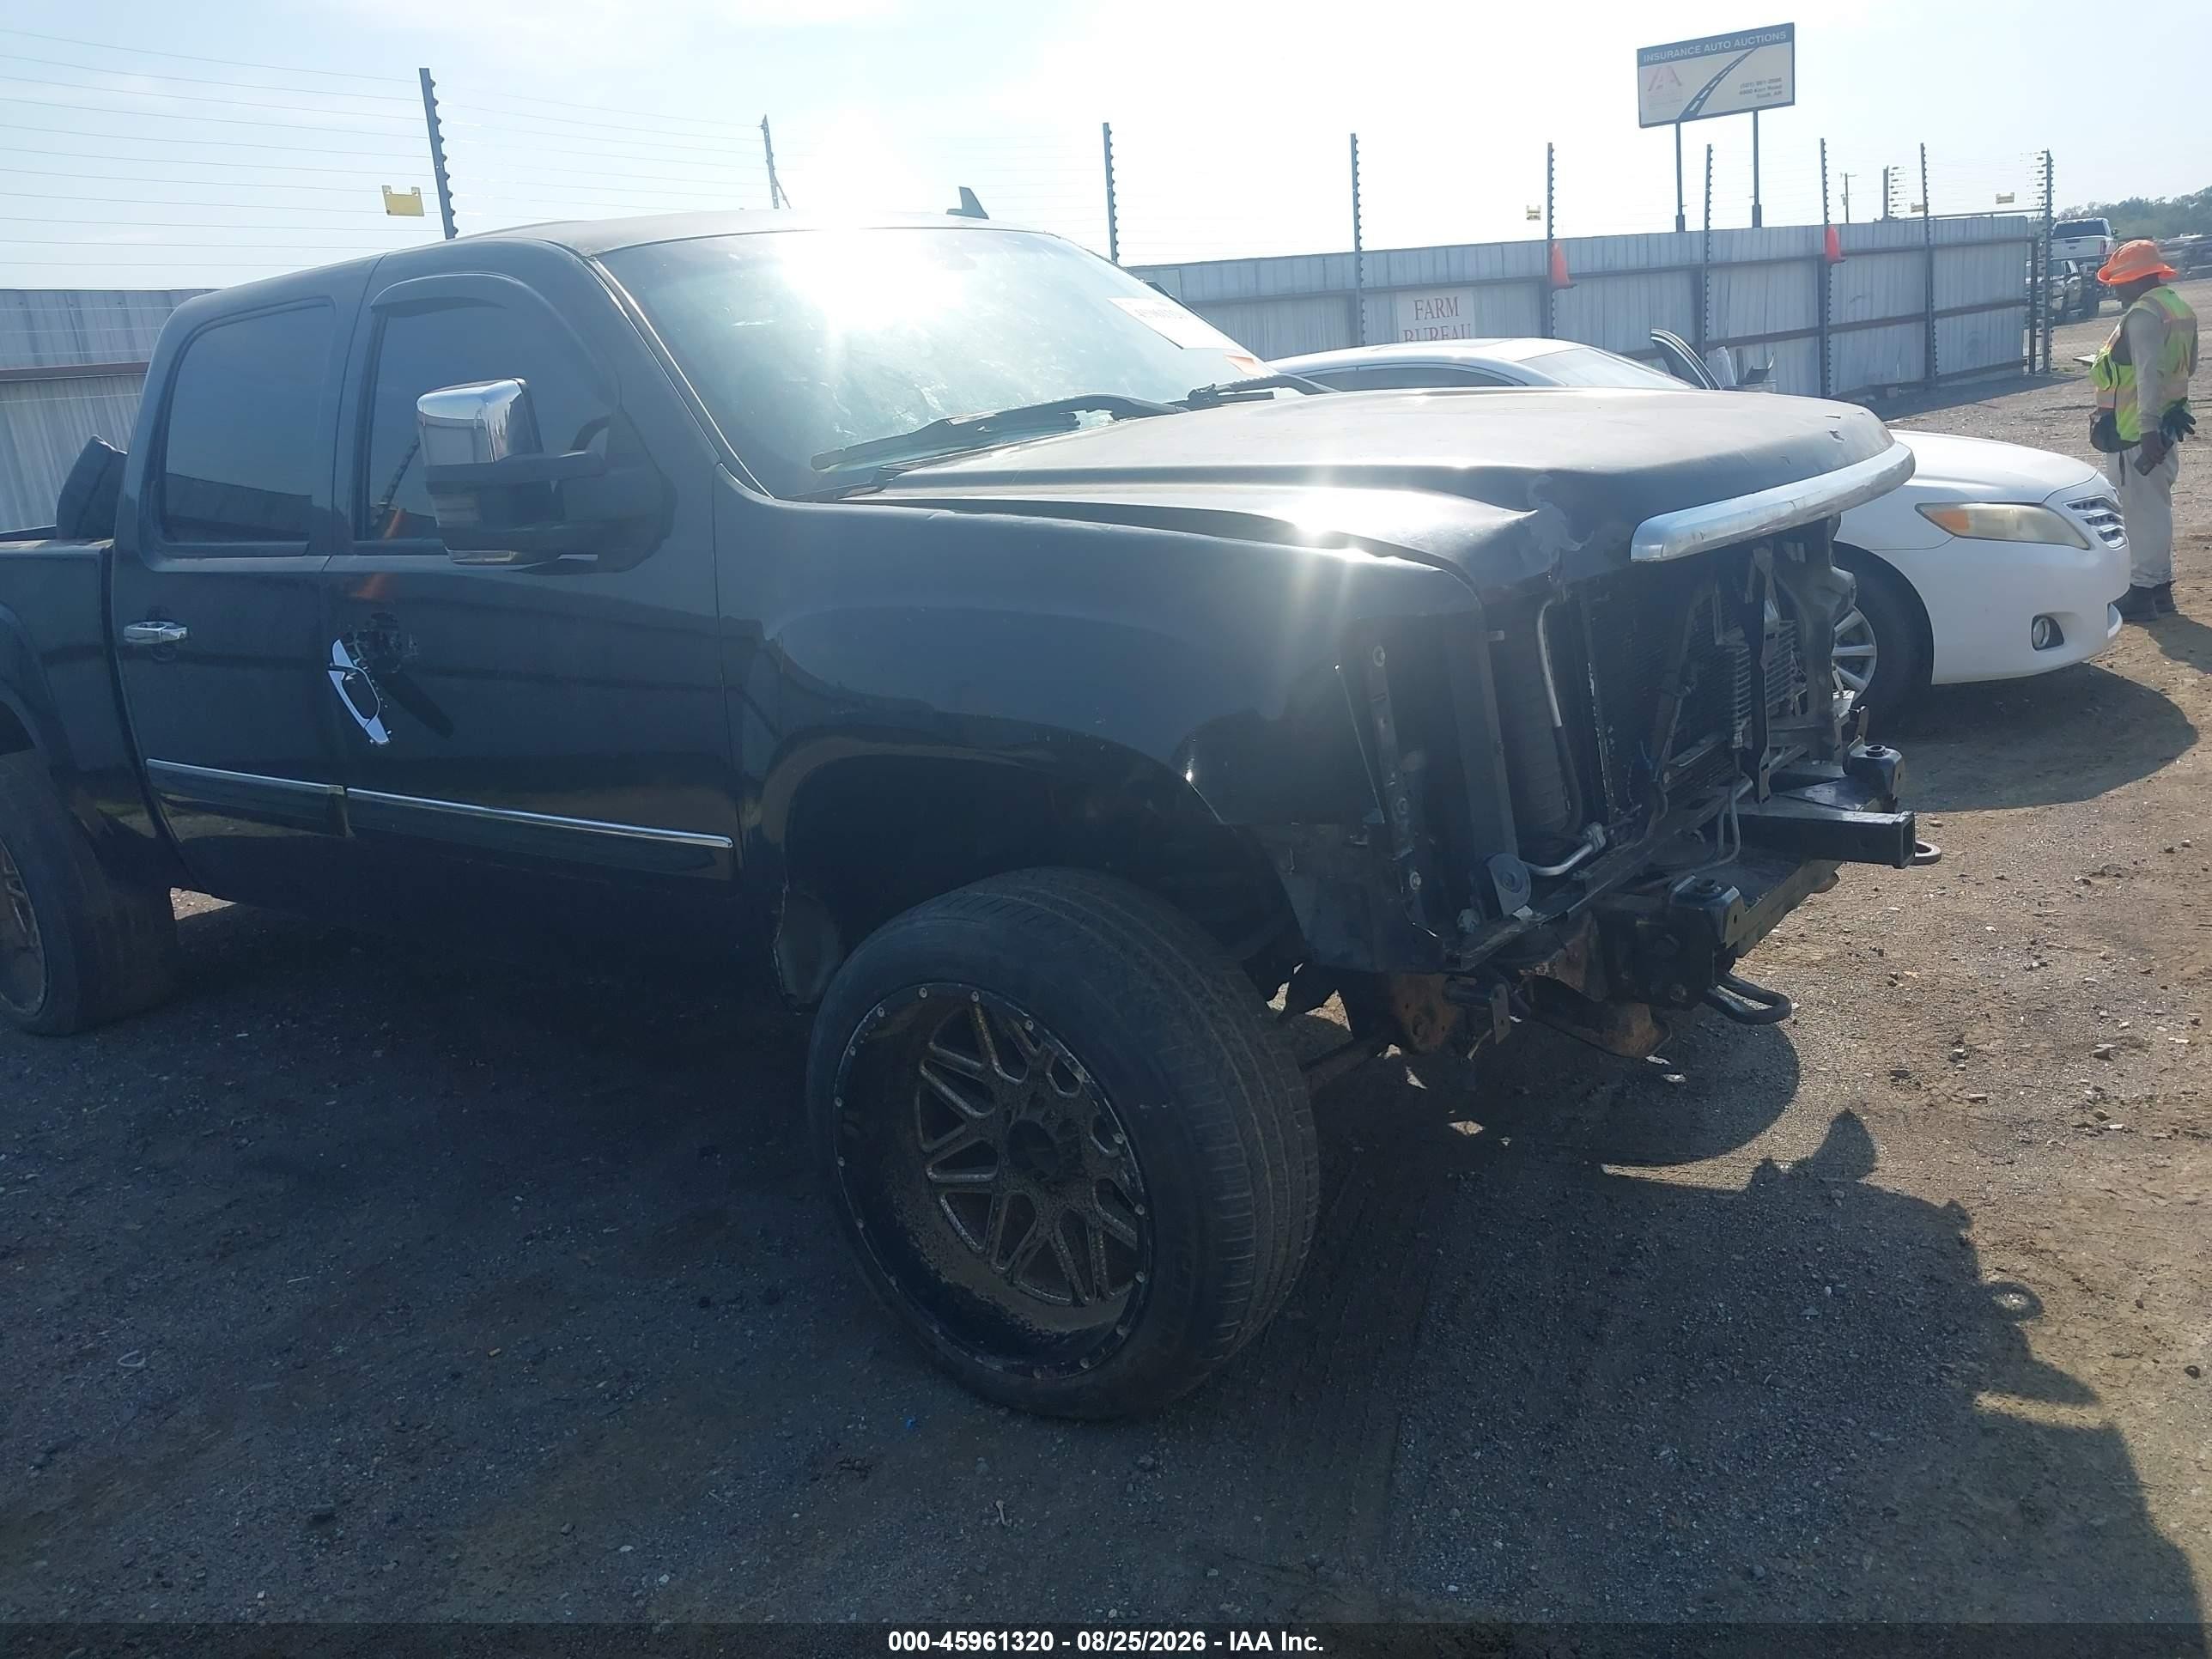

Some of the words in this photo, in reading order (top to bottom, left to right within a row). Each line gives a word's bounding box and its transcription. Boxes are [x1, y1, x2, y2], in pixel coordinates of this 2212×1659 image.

[1644, 46, 1701, 63] INSURANCE
[1704, 41, 1731, 53] AUTO
[1733, 31, 1787, 47] AUCTIONS
[1413, 296, 1460, 320] FARM
